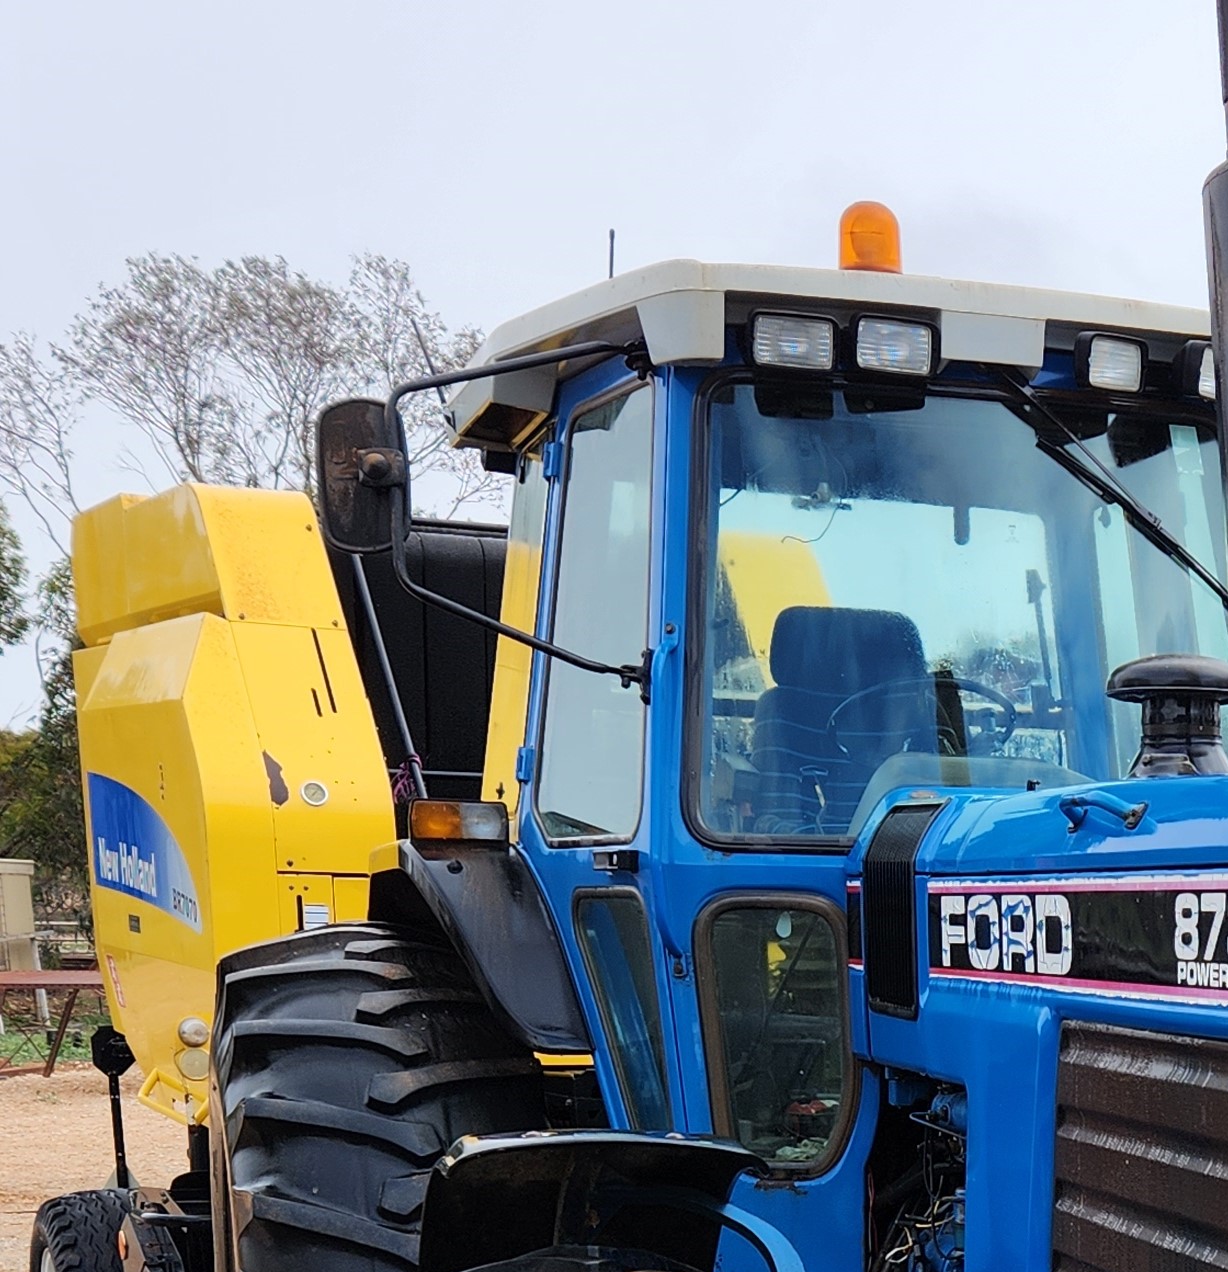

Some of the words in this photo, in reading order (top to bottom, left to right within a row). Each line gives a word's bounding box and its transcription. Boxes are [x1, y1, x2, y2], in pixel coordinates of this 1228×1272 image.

[98, 836, 120, 883] New
[119, 841, 157, 898] Holland
[940, 894, 1073, 976] FORD
